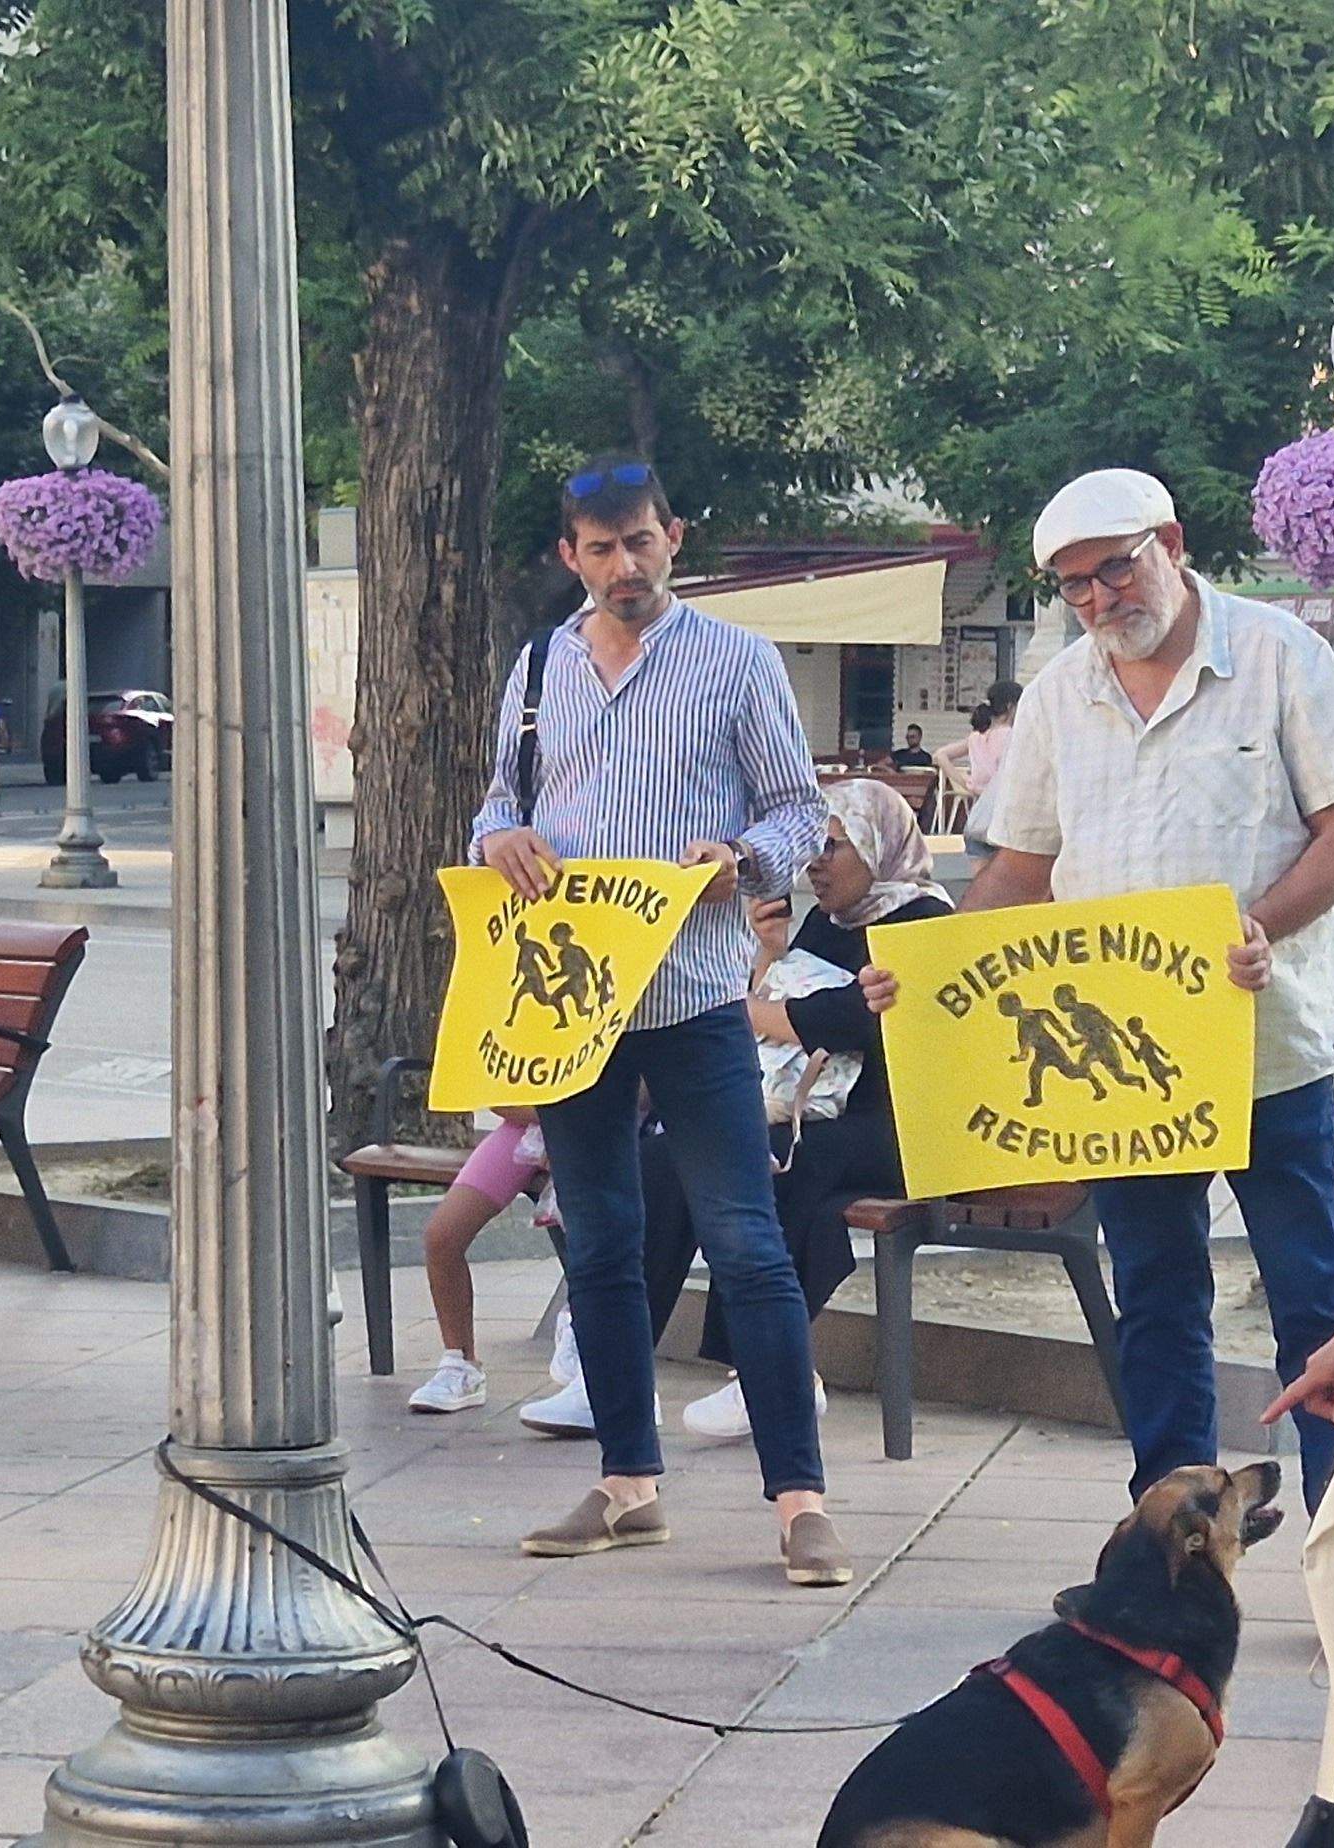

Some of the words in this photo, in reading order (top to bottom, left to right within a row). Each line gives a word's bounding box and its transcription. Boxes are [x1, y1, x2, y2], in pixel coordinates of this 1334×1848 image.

[935, 923, 1211, 1019] BIENVENIDXS
[479, 1009, 623, 1087] REFUGIADXS
[967, 1100, 1220, 1165] REFUGIADXS
